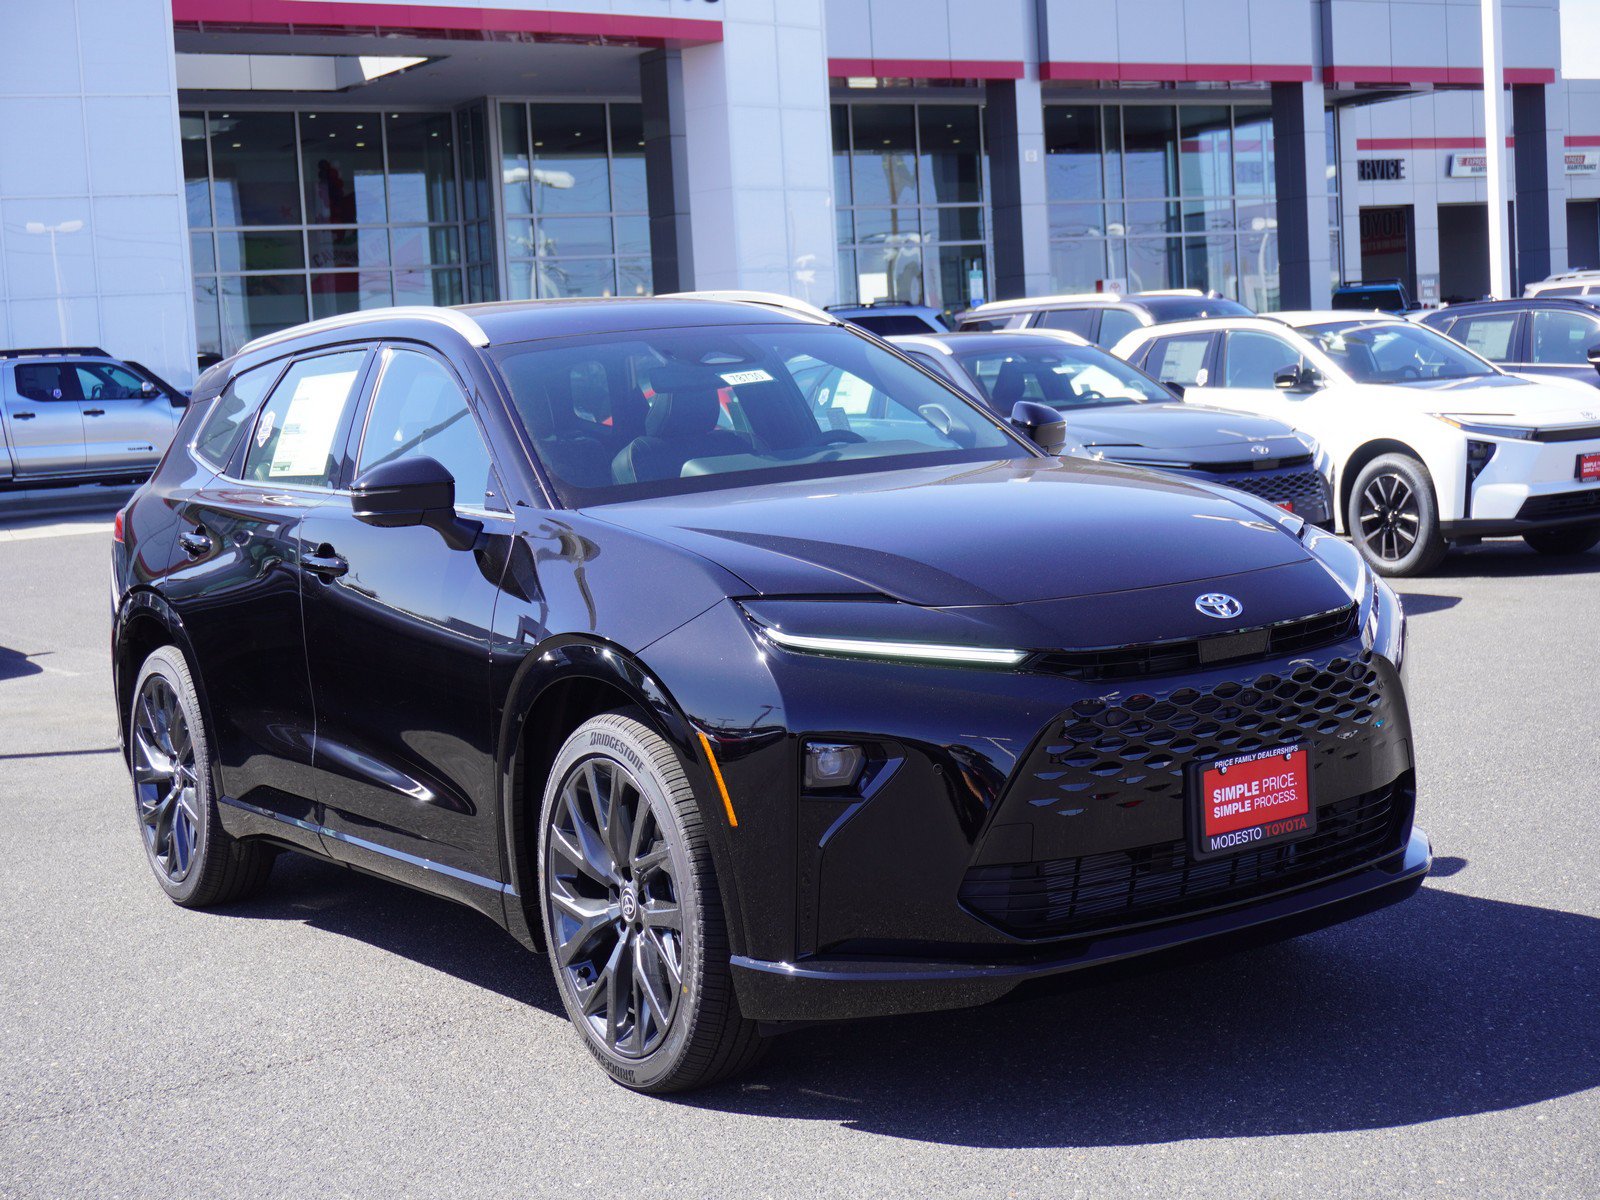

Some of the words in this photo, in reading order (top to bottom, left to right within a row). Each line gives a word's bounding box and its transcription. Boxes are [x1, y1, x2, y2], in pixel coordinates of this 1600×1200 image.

[590, 732, 646, 774] BRIDGESTONE
[1214, 758, 1233, 769] PRICE
[1234, 754, 1256, 764] FAMILY
[1258, 744, 1298, 760] DEALERSHIPS
[1213, 780, 1260, 804] SIMPLE
[1262, 772, 1298, 793] PRICE.
[1213, 800, 1252, 818] SIMPLE
[1254, 789, 1298, 810] PROCESS.
[1211, 828, 1262, 850] MODESTO
[1264, 818, 1308, 837] TOYOTA
